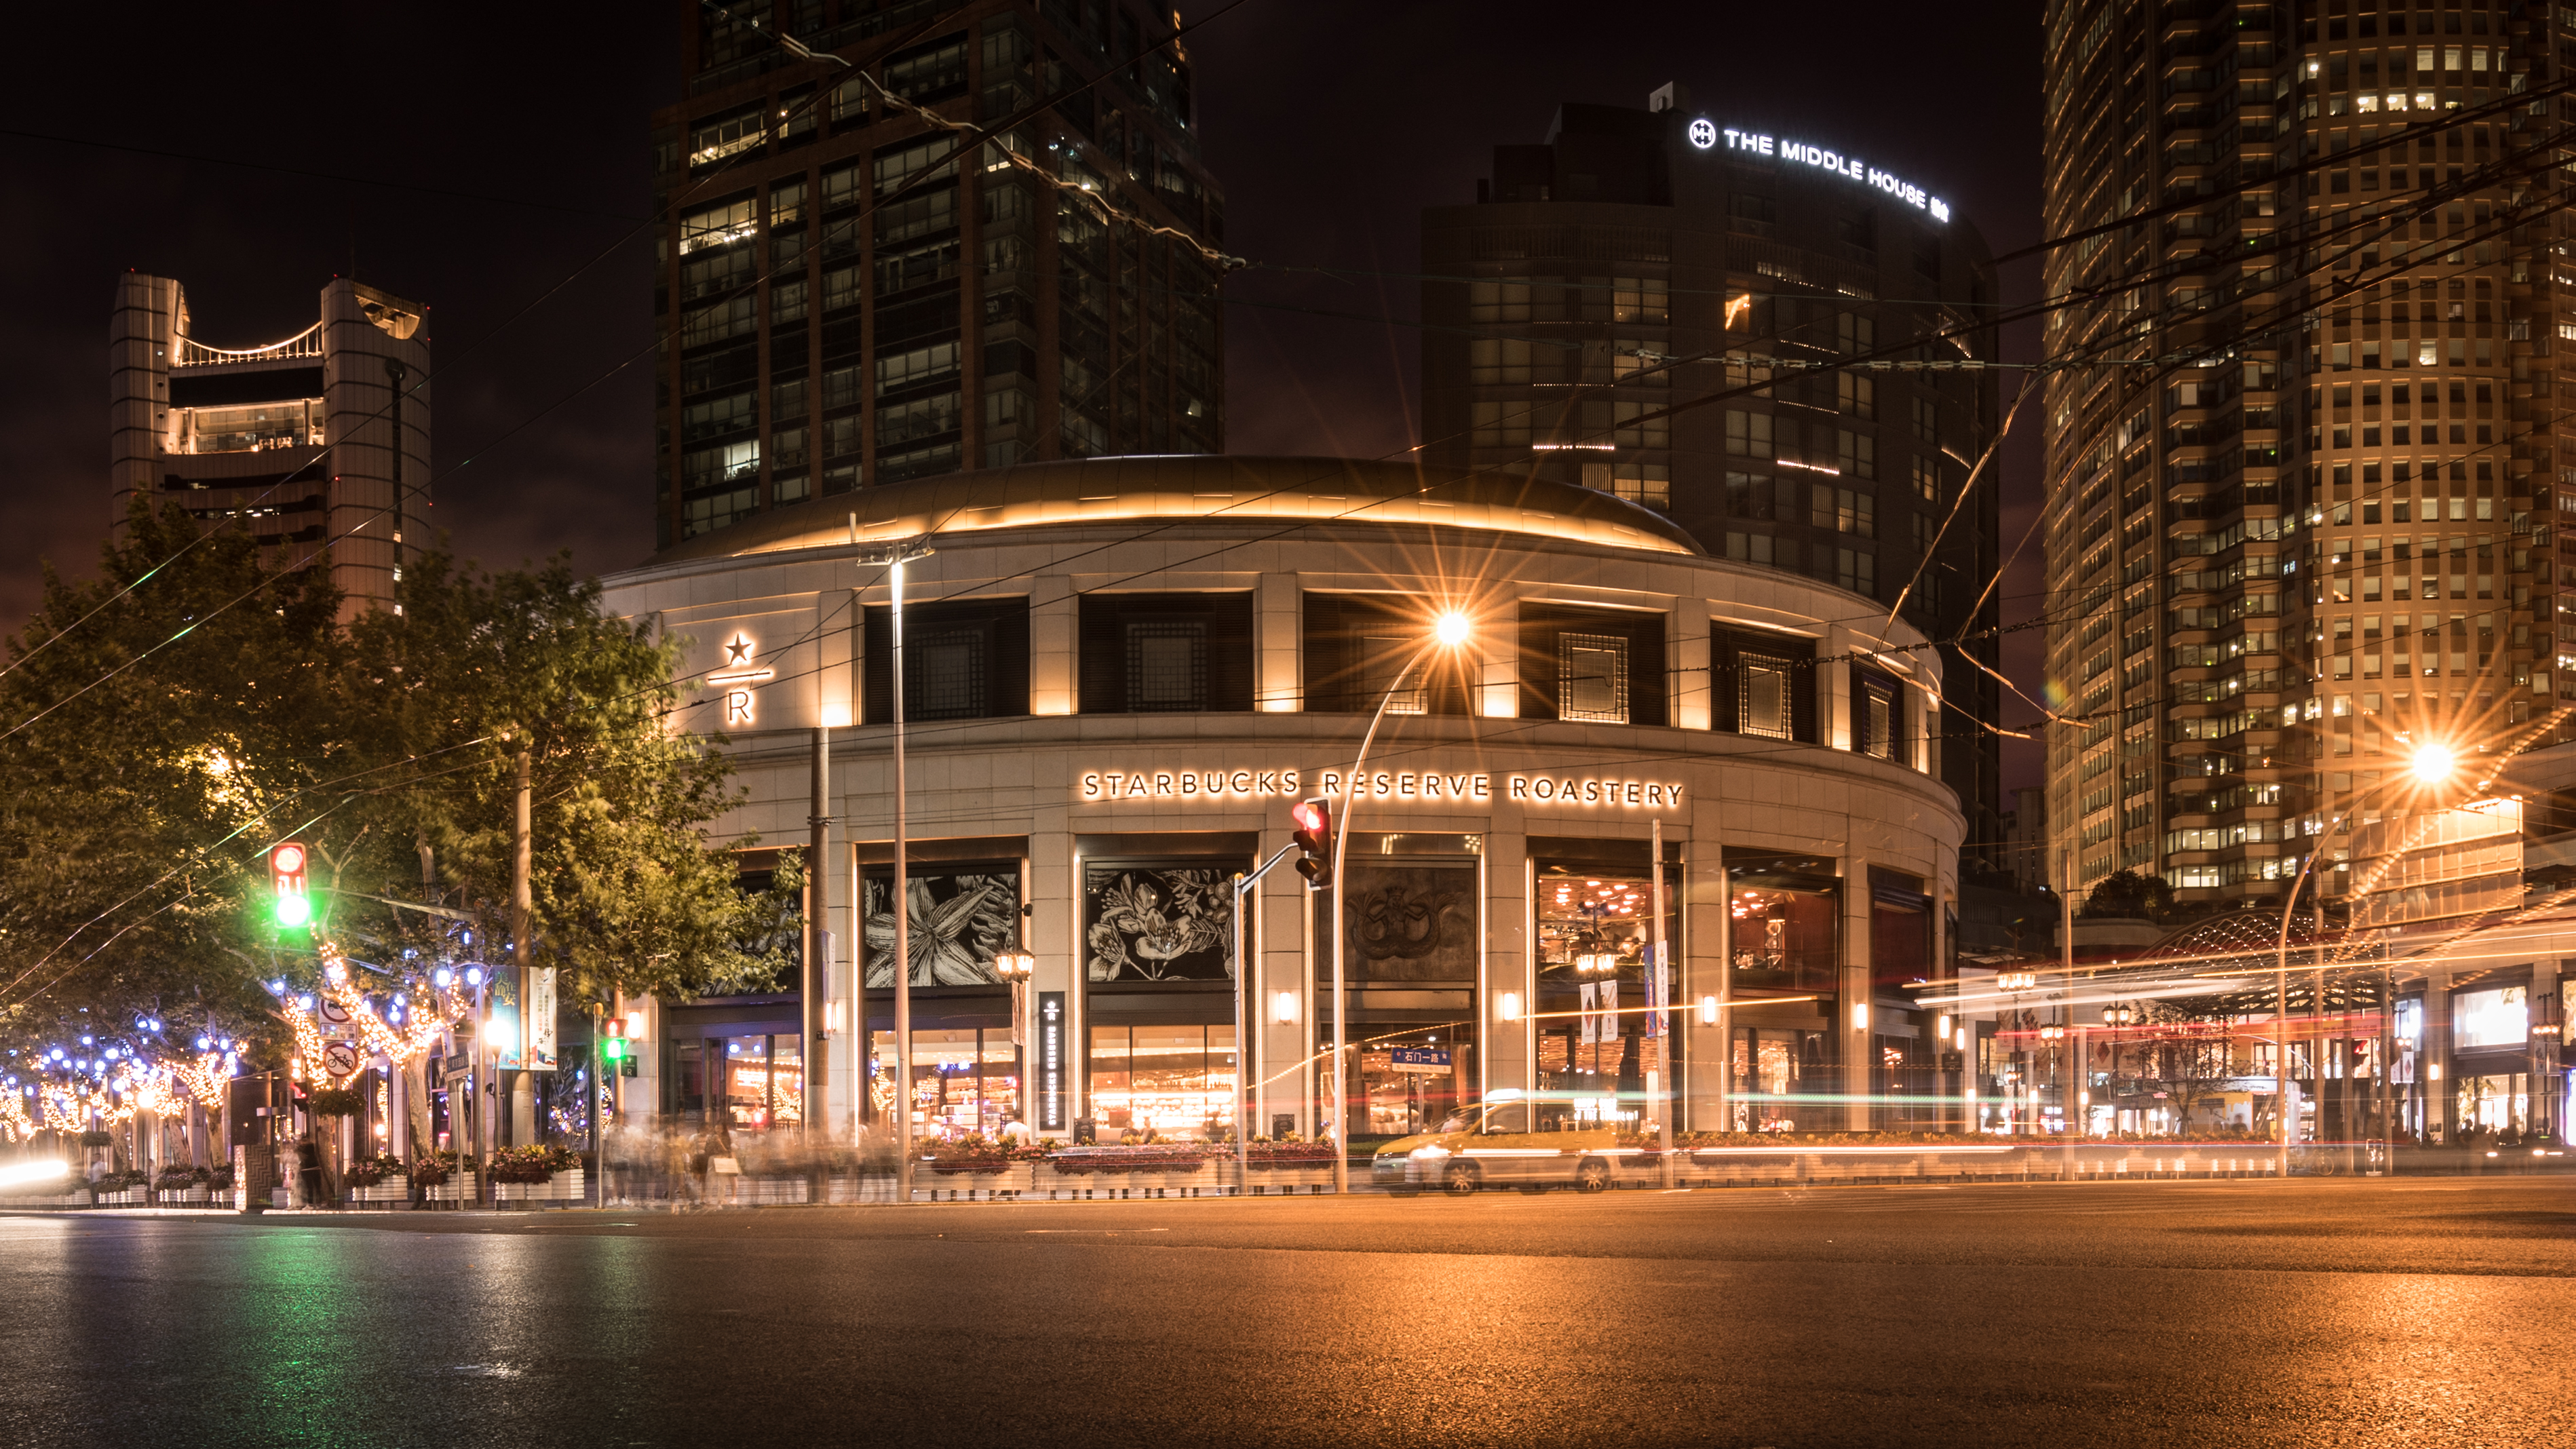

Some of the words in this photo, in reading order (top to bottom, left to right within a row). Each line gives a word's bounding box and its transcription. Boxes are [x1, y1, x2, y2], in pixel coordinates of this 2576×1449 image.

[1724, 130, 1773, 155] THE
[1782, 140, 1863, 180] MIDDLE
[1869, 168, 1925, 209] HOUSE
[729, 691, 749, 720] R
[1085, 772, 1297, 795] STARBUCKS
[1514, 778, 1683, 805] ROASTERY
[1405, 1051, 1439, 1063] 石门一路
[627, 1068, 632, 1076] R
